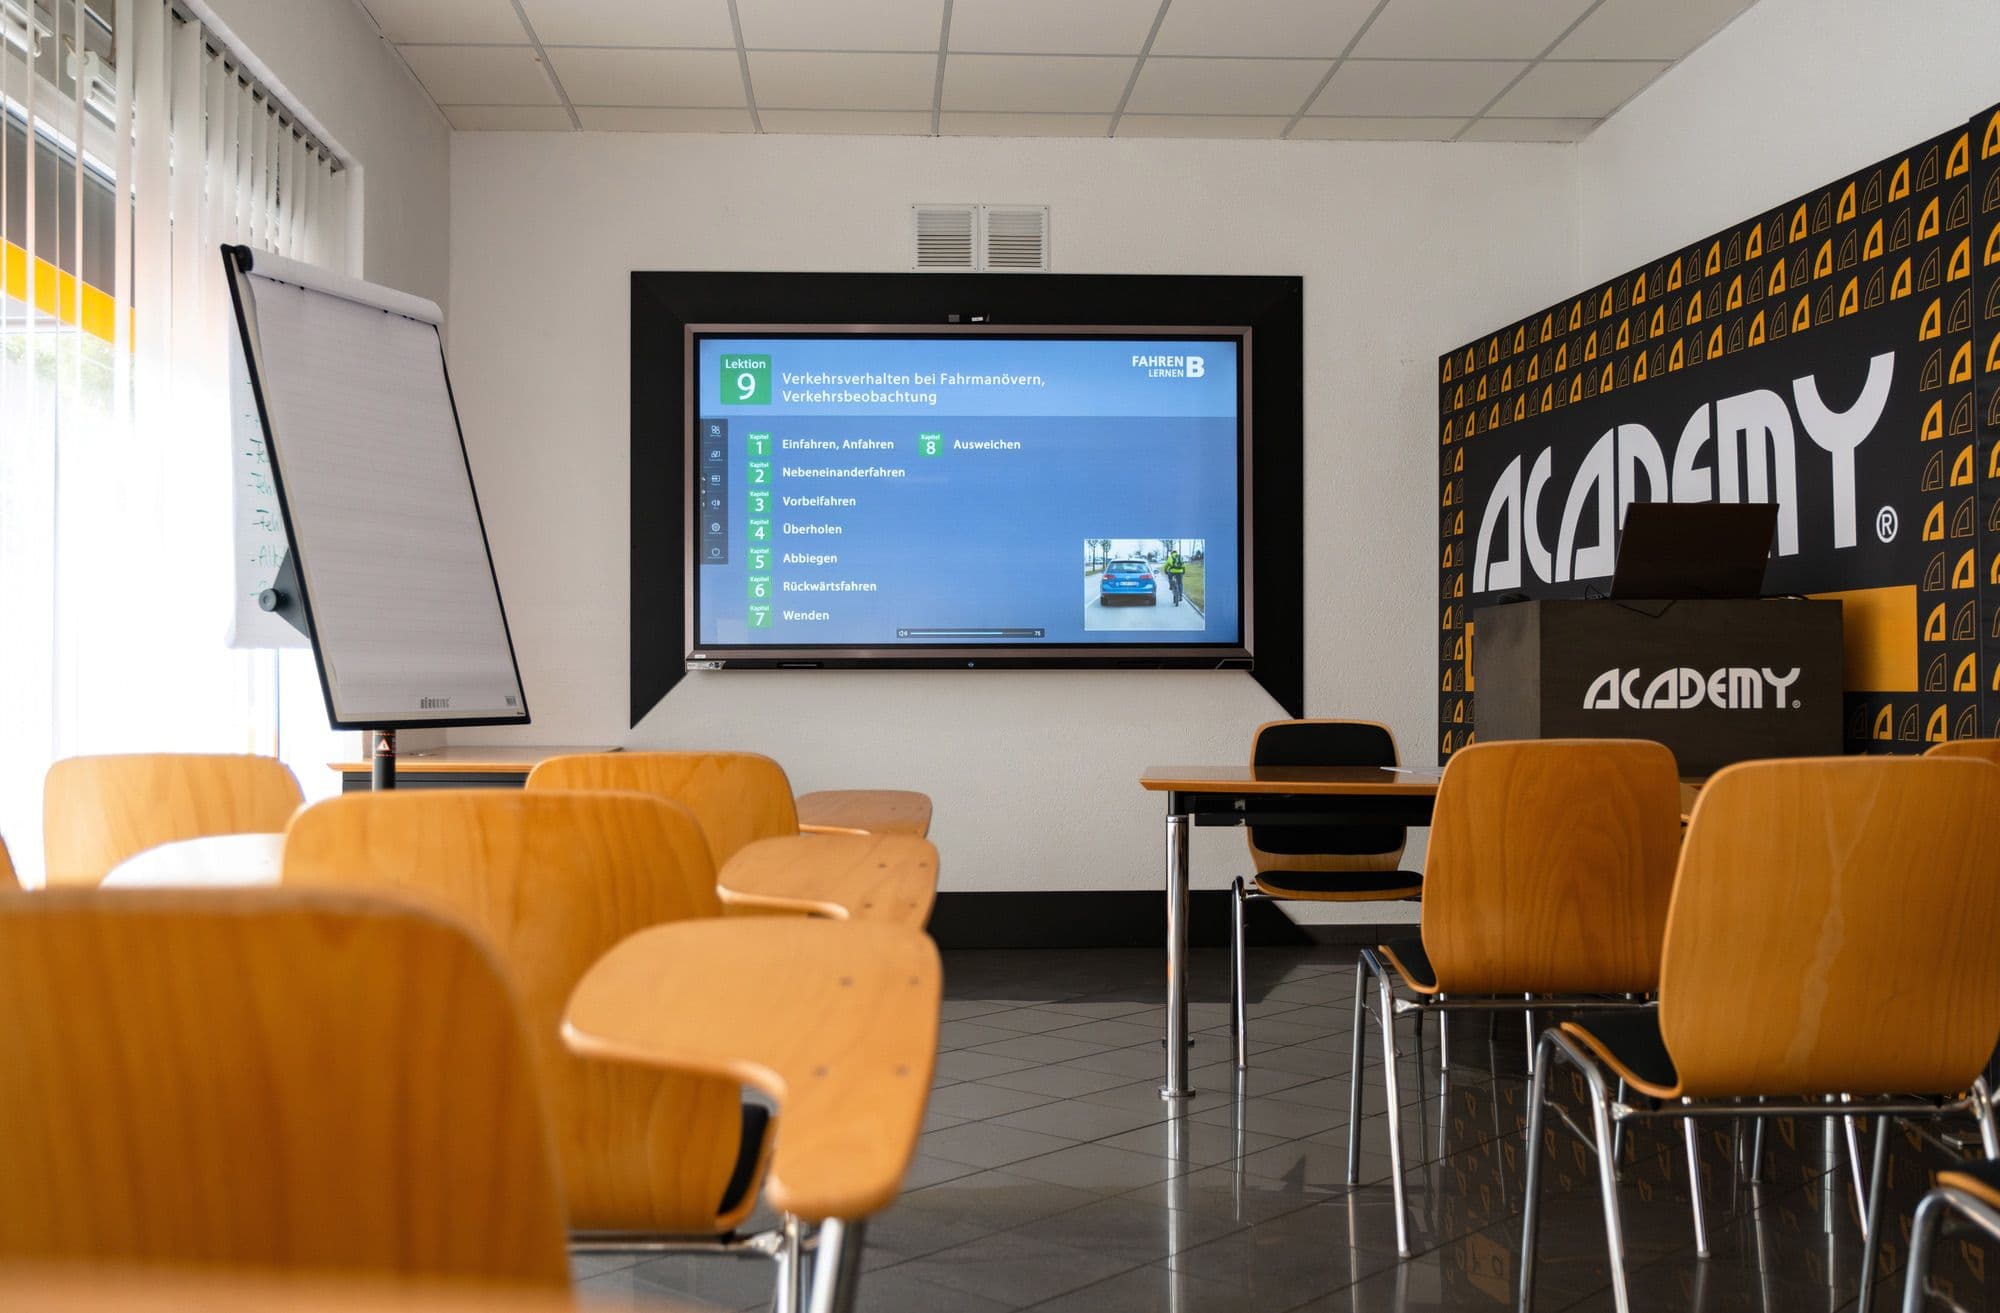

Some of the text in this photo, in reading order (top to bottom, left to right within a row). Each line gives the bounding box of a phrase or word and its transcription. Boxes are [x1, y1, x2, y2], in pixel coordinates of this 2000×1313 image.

[725, 359, 766, 369] Lektion
[1132, 355, 1184, 367] FAHREN
[1186, 356, 1205, 378] B
[782, 372, 1046, 387] Verkehrsverhalten bei Fahrmanövern,
[1148, 368, 1184, 378] LERNEN
[737, 372, 756, 400] 9
[782, 390, 937, 406] Verkehrsbeobachtung
[755, 441, 764, 455] 1
[782, 439, 895, 451] Einfahren, Anfahren
[926, 441, 936, 455] 8
[953, 439, 1021, 450] Ausweichen
[754, 469, 765, 483] 2
[782, 467, 906, 478] Nebeneinanderfahren
[754, 498, 765, 512] 3
[782, 496, 856, 506] Vorbeifahren
[754, 526, 766, 540] 4
[783, 522, 843, 535] Überholen
[755, 555, 765, 569] 5
[783, 553, 838, 566] Abbiegen
[755, 583, 765, 597] 6
[783, 581, 877, 592] Rückwärtsfahren
[755, 612, 765, 626] 7
[783, 610, 830, 621] Wenden
